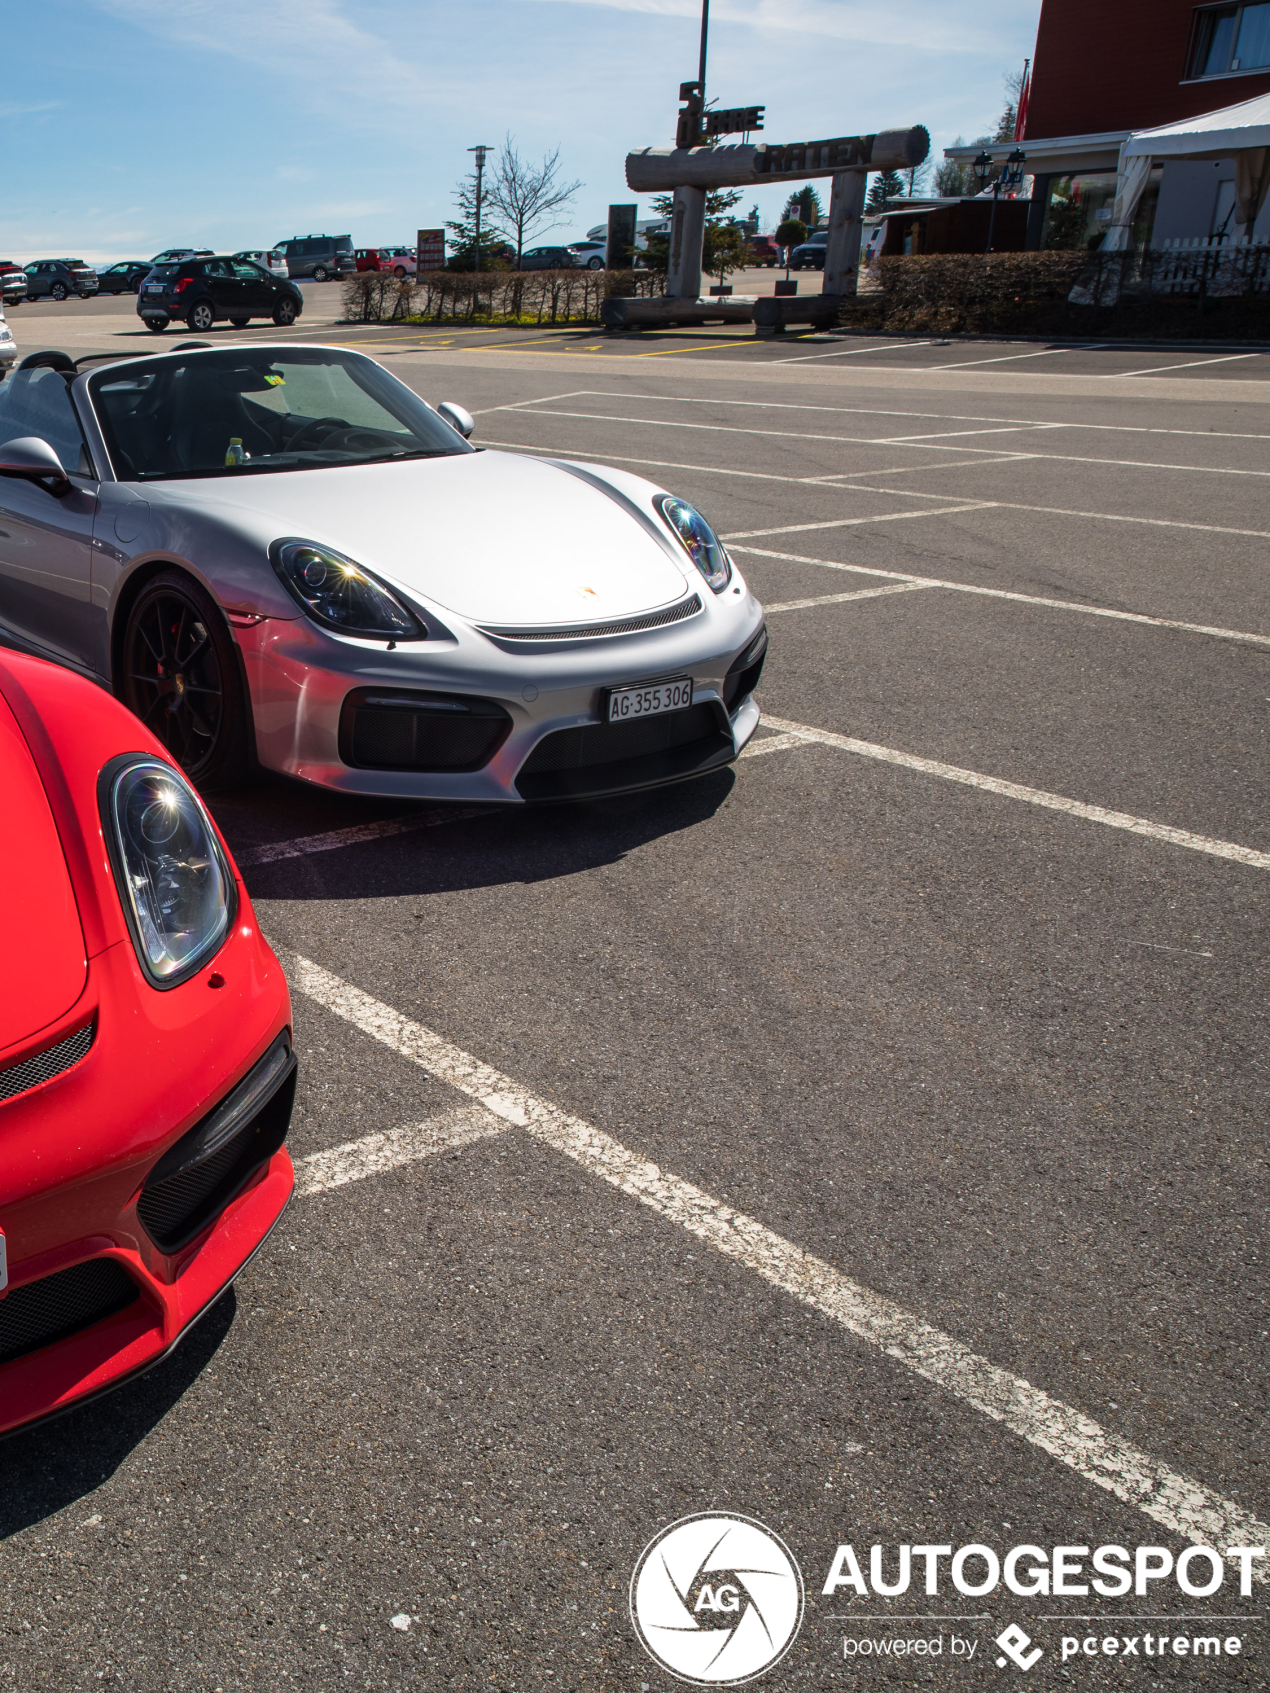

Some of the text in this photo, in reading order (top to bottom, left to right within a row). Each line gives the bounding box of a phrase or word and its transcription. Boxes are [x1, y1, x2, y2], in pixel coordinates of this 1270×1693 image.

[676, 81, 765, 148] 50 JAHRE
[763, 134, 877, 173] RATEN
